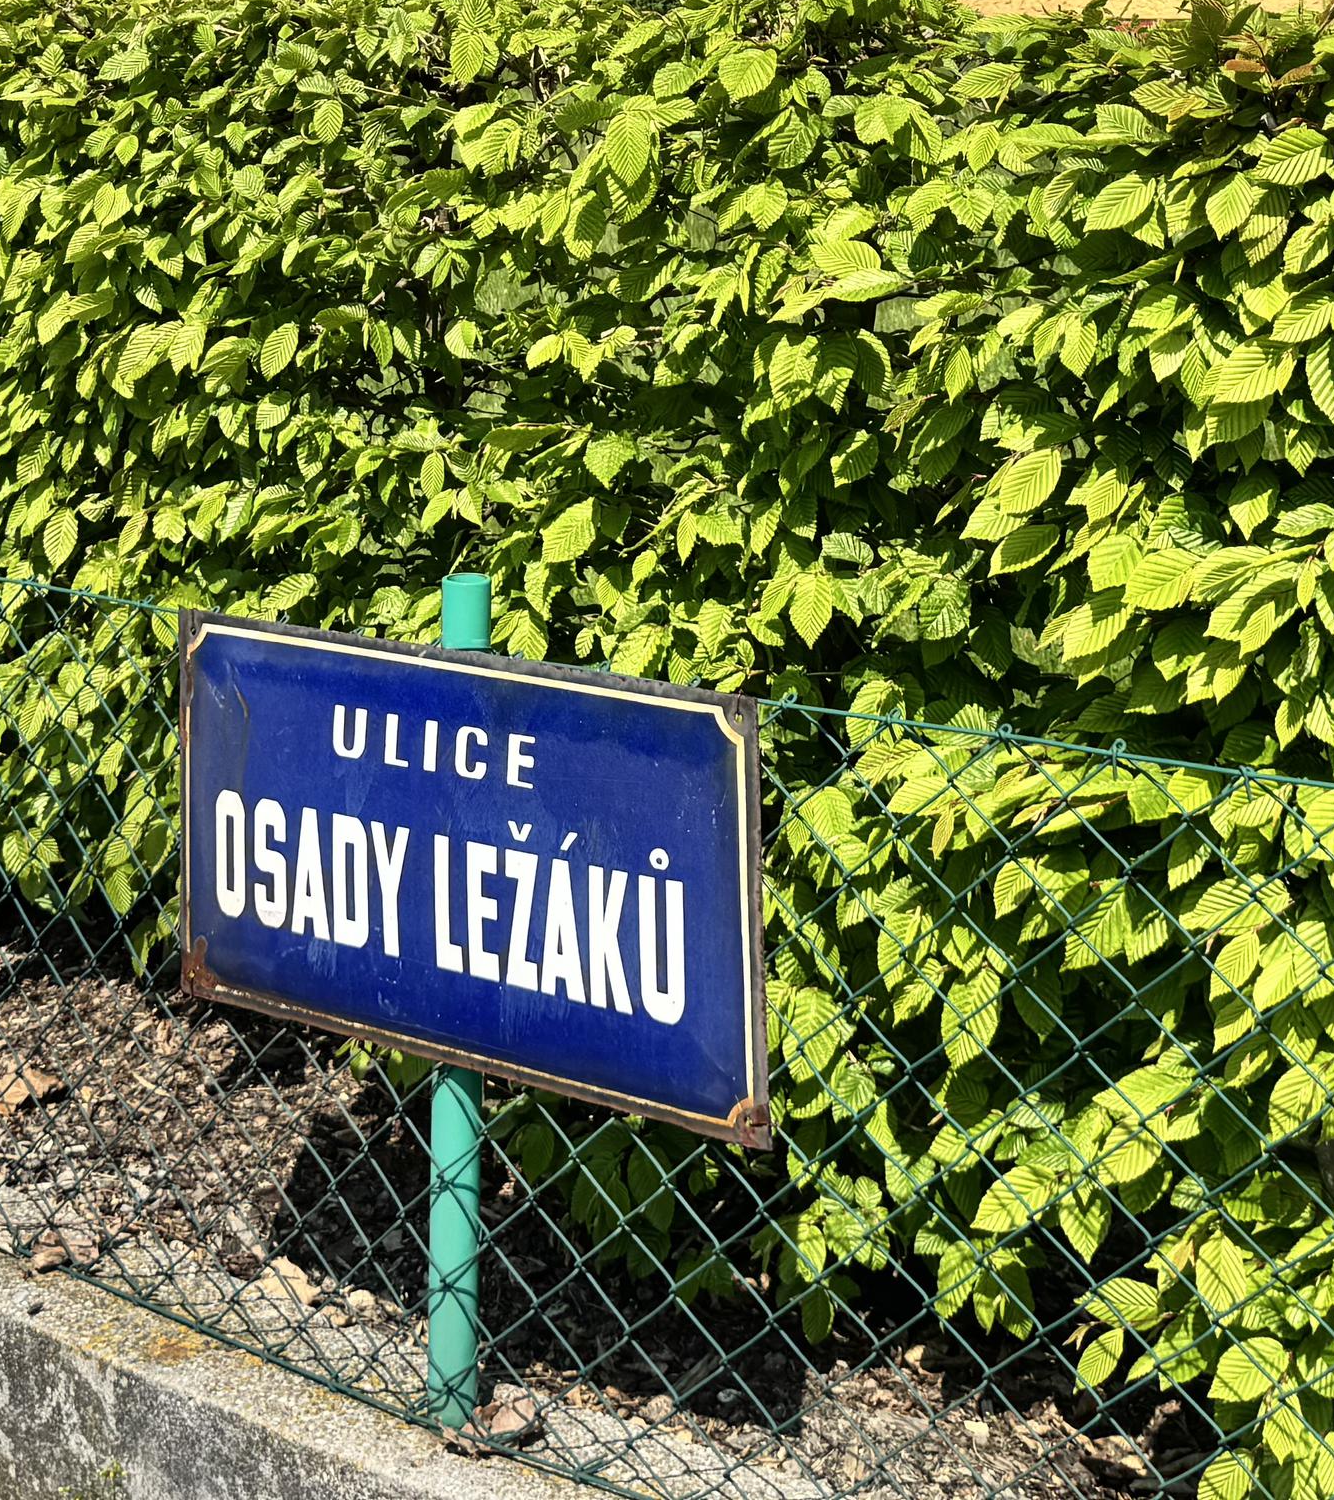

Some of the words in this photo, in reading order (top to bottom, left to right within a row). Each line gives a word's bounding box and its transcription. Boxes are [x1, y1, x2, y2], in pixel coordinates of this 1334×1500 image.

[332, 704, 536, 790] ULICE
[215, 789, 410, 958] OSADY
[433, 820, 686, 1026] LEŽÁKŮ
